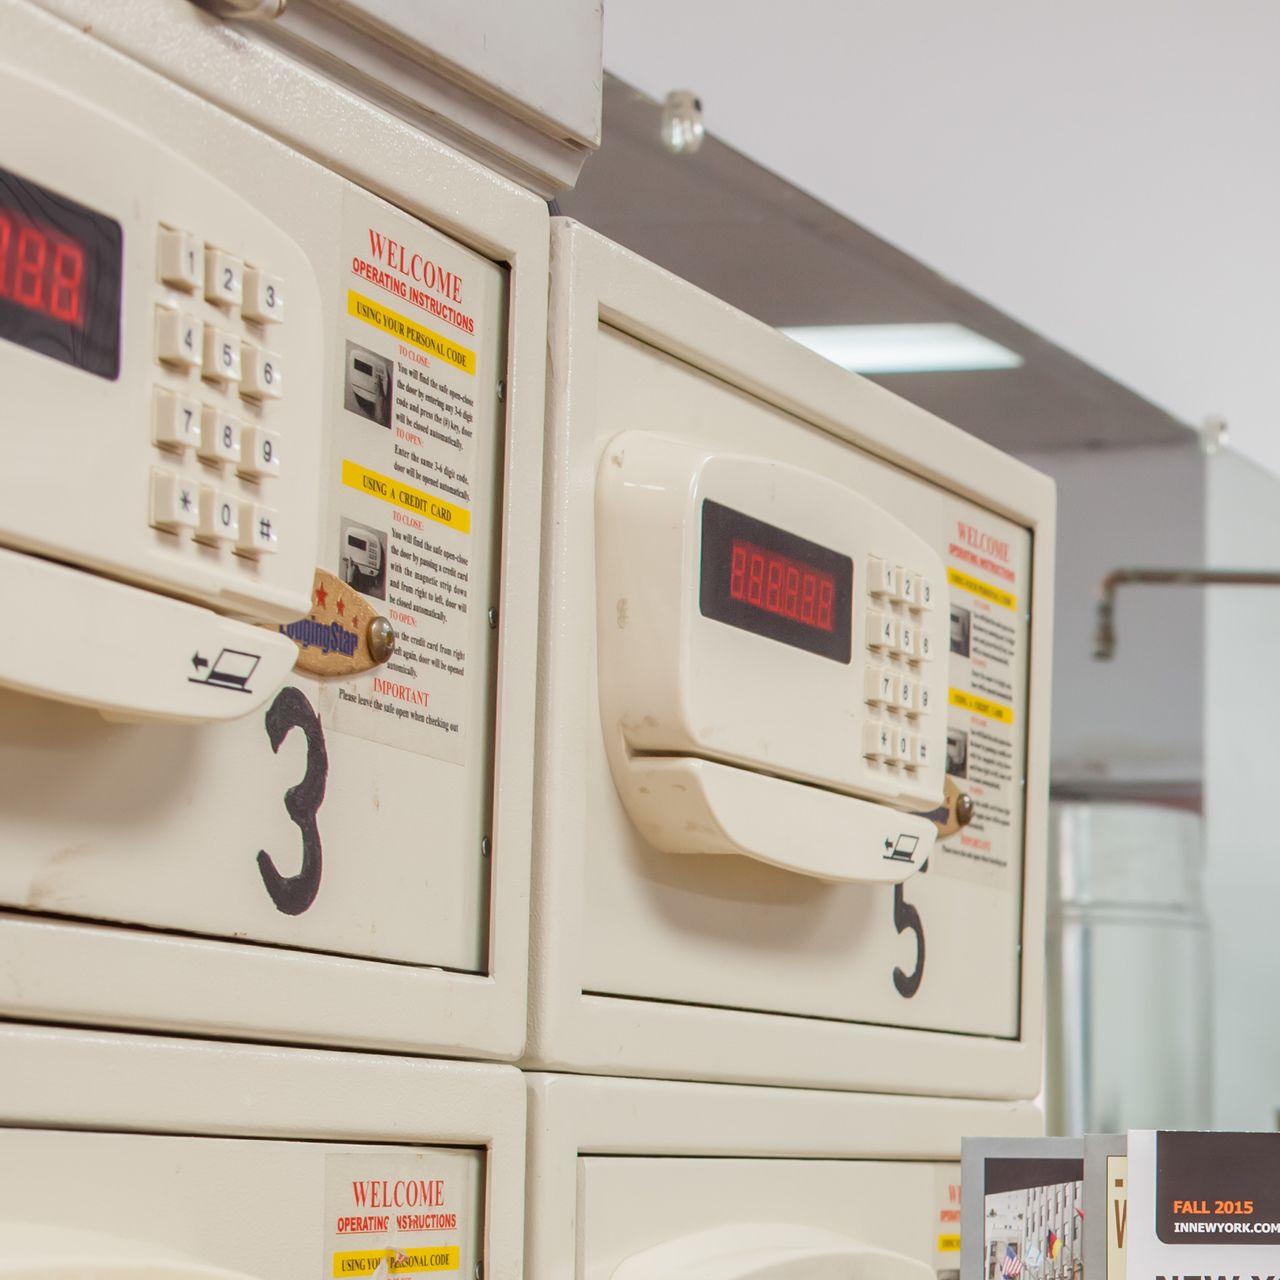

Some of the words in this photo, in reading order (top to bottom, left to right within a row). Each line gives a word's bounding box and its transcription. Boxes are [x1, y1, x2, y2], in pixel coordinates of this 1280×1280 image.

[369, 229, 462, 304] WELCOME
[223, 268, 233, 291] 2
[266, 286, 276, 307] 3
[352, 257, 406, 298] OPERATING
[409, 286, 474, 333] INSTRUCTIONS
[357, 301, 381, 323] USING
[383, 315, 404, 336] YOUR
[406, 326, 445, 354] PERSONAL
[448, 346, 467, 367] CODE
[185, 329, 193, 351] 4
[223, 344, 232, 366] 5
[264, 363, 273, 385] 6
[419, 373, 429, 385] find
[430, 378, 438, 389] the
[439, 383, 448, 394] safe
[183, 411, 193, 434] 7
[223, 426, 232, 448] 8
[262, 441, 272, 463] 9
[394, 444, 410, 458] Enter
[411, 451, 419, 462] the
[420, 457, 433, 469] same
[221, 504, 231, 526] 0
[363, 475, 387, 496] USING
[390, 488, 396, 499] A
[399, 491, 428, 512] CREDIT
[431, 503, 452, 522] CARD
[339, 688, 357, 702] Please
[358, 694, 373, 708] leave
[374, 699, 383, 710] the
[384, 702, 395, 714] safe
[396, 706, 409, 719] open
[410, 709, 425, 723] when
[425, 714, 449, 731] checking
[450, 724, 459, 733] out
[373, 678, 430, 707] IMPORTANT
[256, 686, 328, 916] 3
[893, 857, 928, 999] 5
[352, 1180, 444, 1208] WELCOME
[1173, 1200, 1210, 1215] FALL
[1214, 1201, 1254, 1214] 2015
[396, 1214, 456, 1230] NSTRUCTIONS
[1174, 1222, 1280, 1234] INNEWYORK.COM
[341, 1259, 365, 1271] USING
[430, 1254, 449, 1266] CODE
